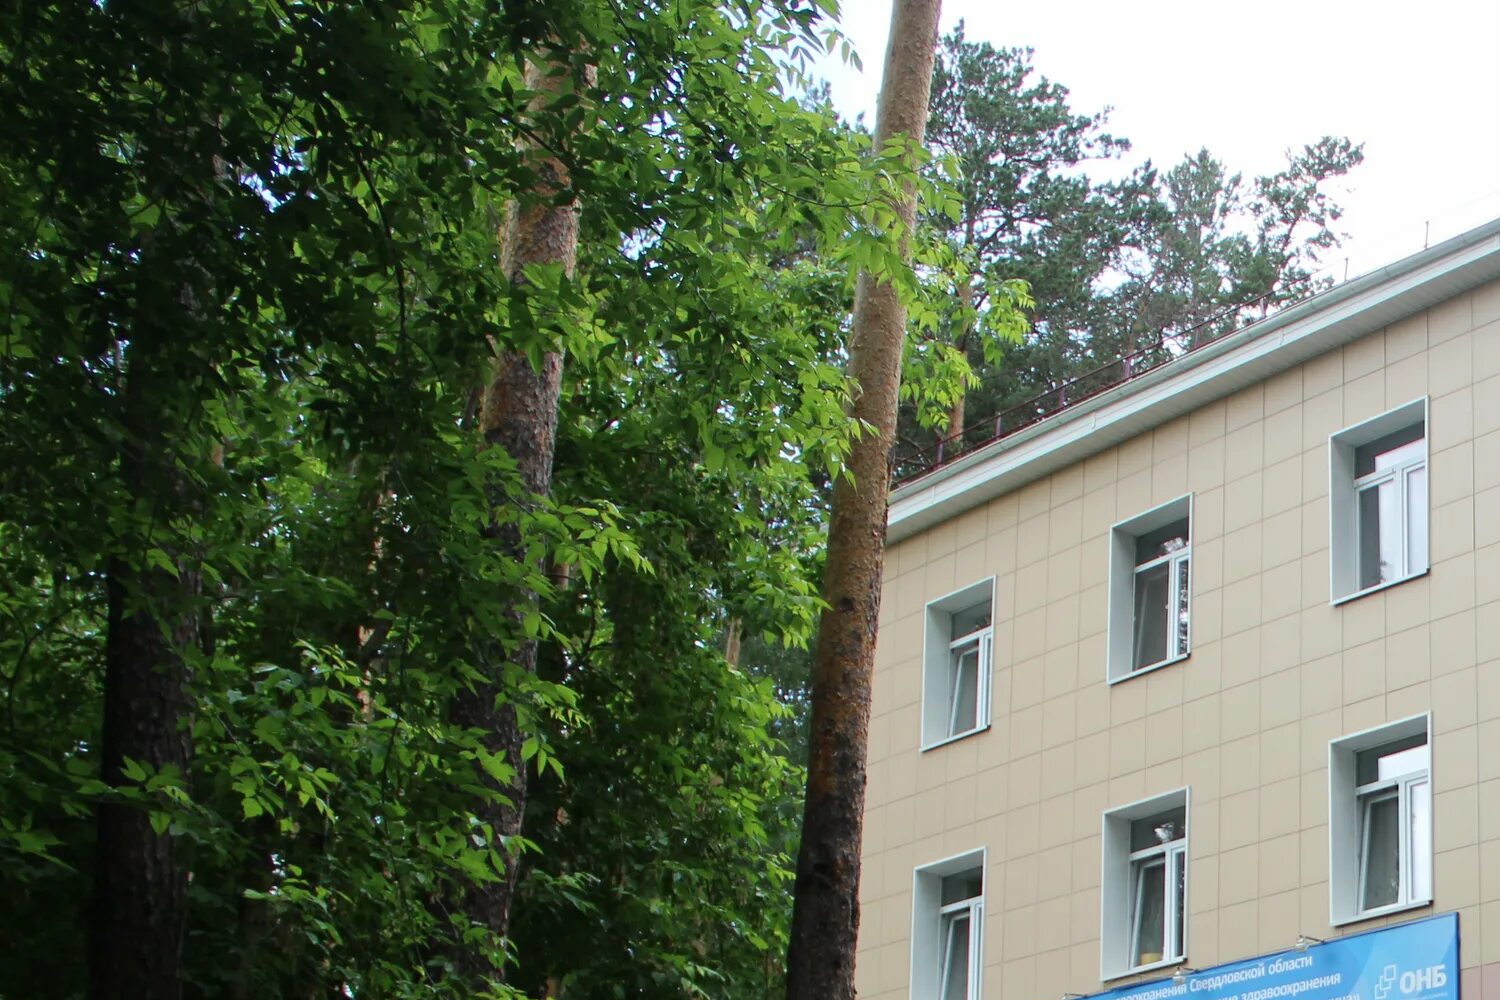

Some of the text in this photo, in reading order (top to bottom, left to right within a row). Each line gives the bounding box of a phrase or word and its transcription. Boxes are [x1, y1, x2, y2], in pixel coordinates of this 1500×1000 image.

[1190, 963, 1265, 992] Свердловской
[1268, 955, 1313, 975] области
[1400, 964, 1447, 994] ОНБ
